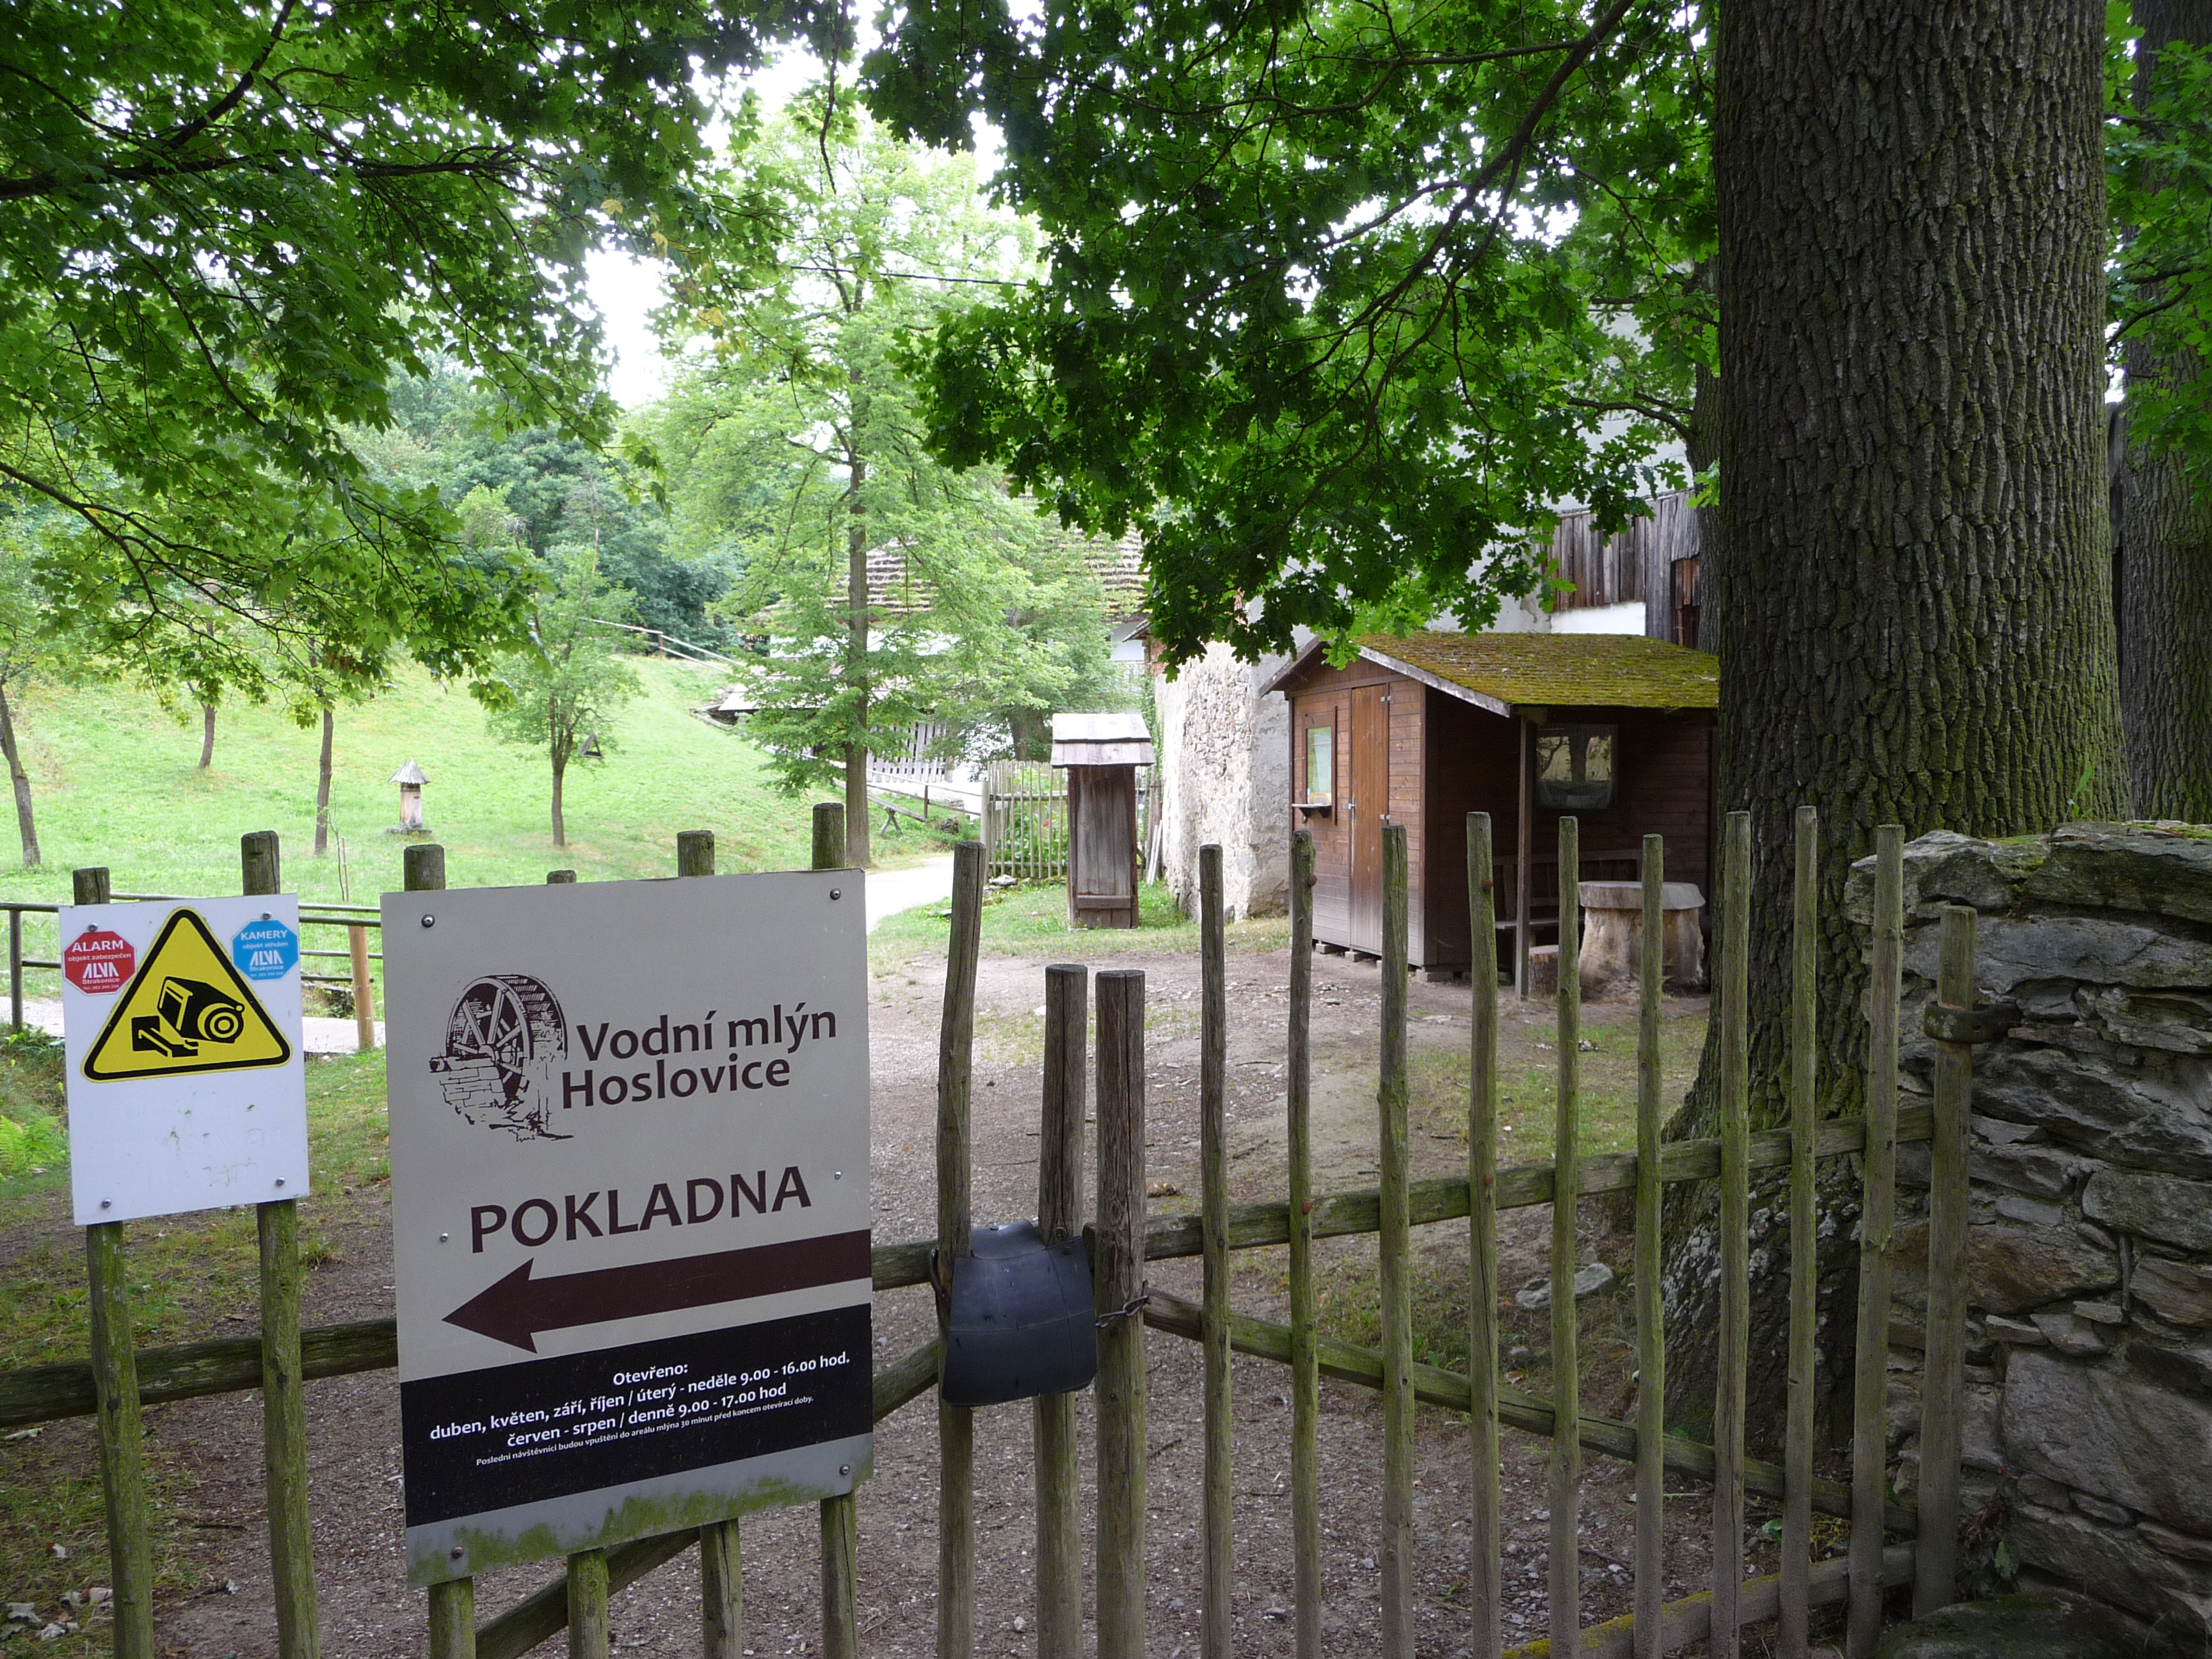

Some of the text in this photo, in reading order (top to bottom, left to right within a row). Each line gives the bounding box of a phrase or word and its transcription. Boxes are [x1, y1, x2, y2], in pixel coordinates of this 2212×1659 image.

[72, 940, 124, 952] ALARM
[241, 929, 287, 940] KAMERY
[249, 950, 284, 966] ALVA
[82, 962, 119, 979] ALVA
[577, 1002, 837, 1061] Vodní mlýn
[562, 1053, 791, 1109] Hoslovice
[470, 1166, 812, 1254] POKLADNA
[429, 1422, 486, 1439] duben,
[490, 1410, 550, 1429] květen,
[553, 1399, 586, 1417] září,
[590, 1395, 625, 1412] říjen
[628, 1390, 634, 1406] /
[637, 1383, 677, 1402] úterý
[688, 1373, 737, 1393] neděle
[740, 1368, 771, 1386] 9.00
[781, 1359, 817, 1375] 16.00
[820, 1351, 850, 1368] hod.
[613, 1364, 688, 1385] Otevřeno:
[476, 1452, 511, 1466] Poslední
[512, 1443, 557, 1459] návštěvníci
[558, 1439, 584, 1450] budou
[631, 1426, 655, 1437] areálu
[656, 1422, 679, 1433] mlýna
[680, 1420, 690, 1428] 30
[691, 1415, 713, 1425] minut
[714, 1410, 732, 1422] před
[732, 1406, 761, 1416] koncem
[762, 1398, 794, 1411] otevírací
[794, 1396, 813, 1405] doby.
[507, 1428, 561, 1447] červen
[573, 1418, 616, 1436] srpen
[619, 1412, 625, 1429] /
[628, 1403, 675, 1424] denně
[678, 1400, 709, 1417] 9.00
[721, 1391, 756, 1408] 17.00
[760, 1382, 787, 1399] hod
